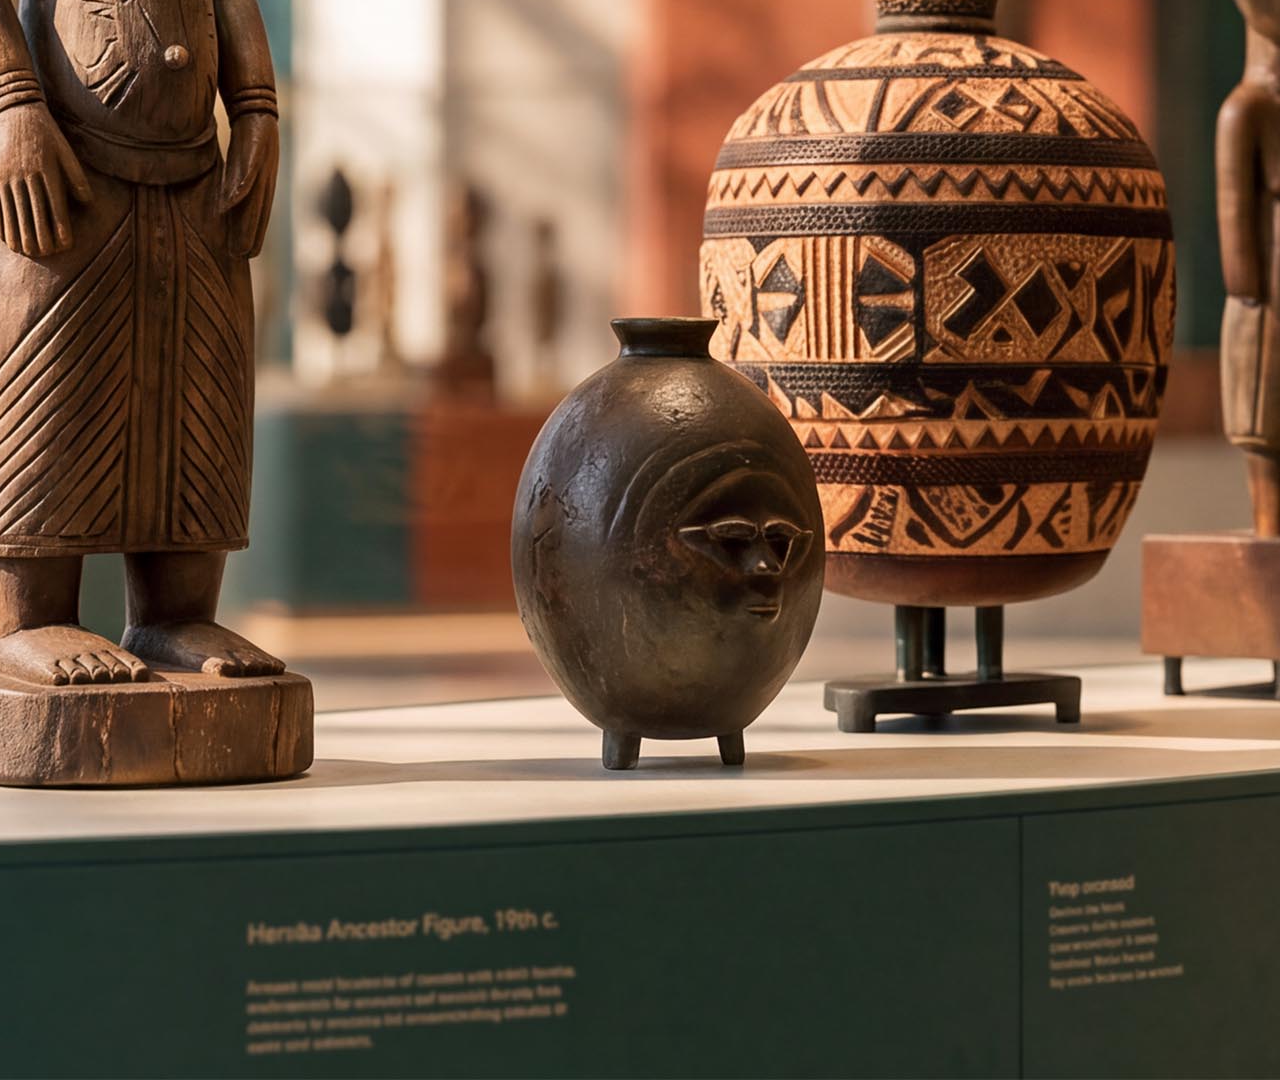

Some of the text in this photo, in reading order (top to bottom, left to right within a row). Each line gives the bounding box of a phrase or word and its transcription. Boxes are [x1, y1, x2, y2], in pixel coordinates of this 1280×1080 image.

[327, 918, 418, 941] Ancestor
[423, 913, 489, 940] Figure,
[495, 909, 537, 931] 19th
